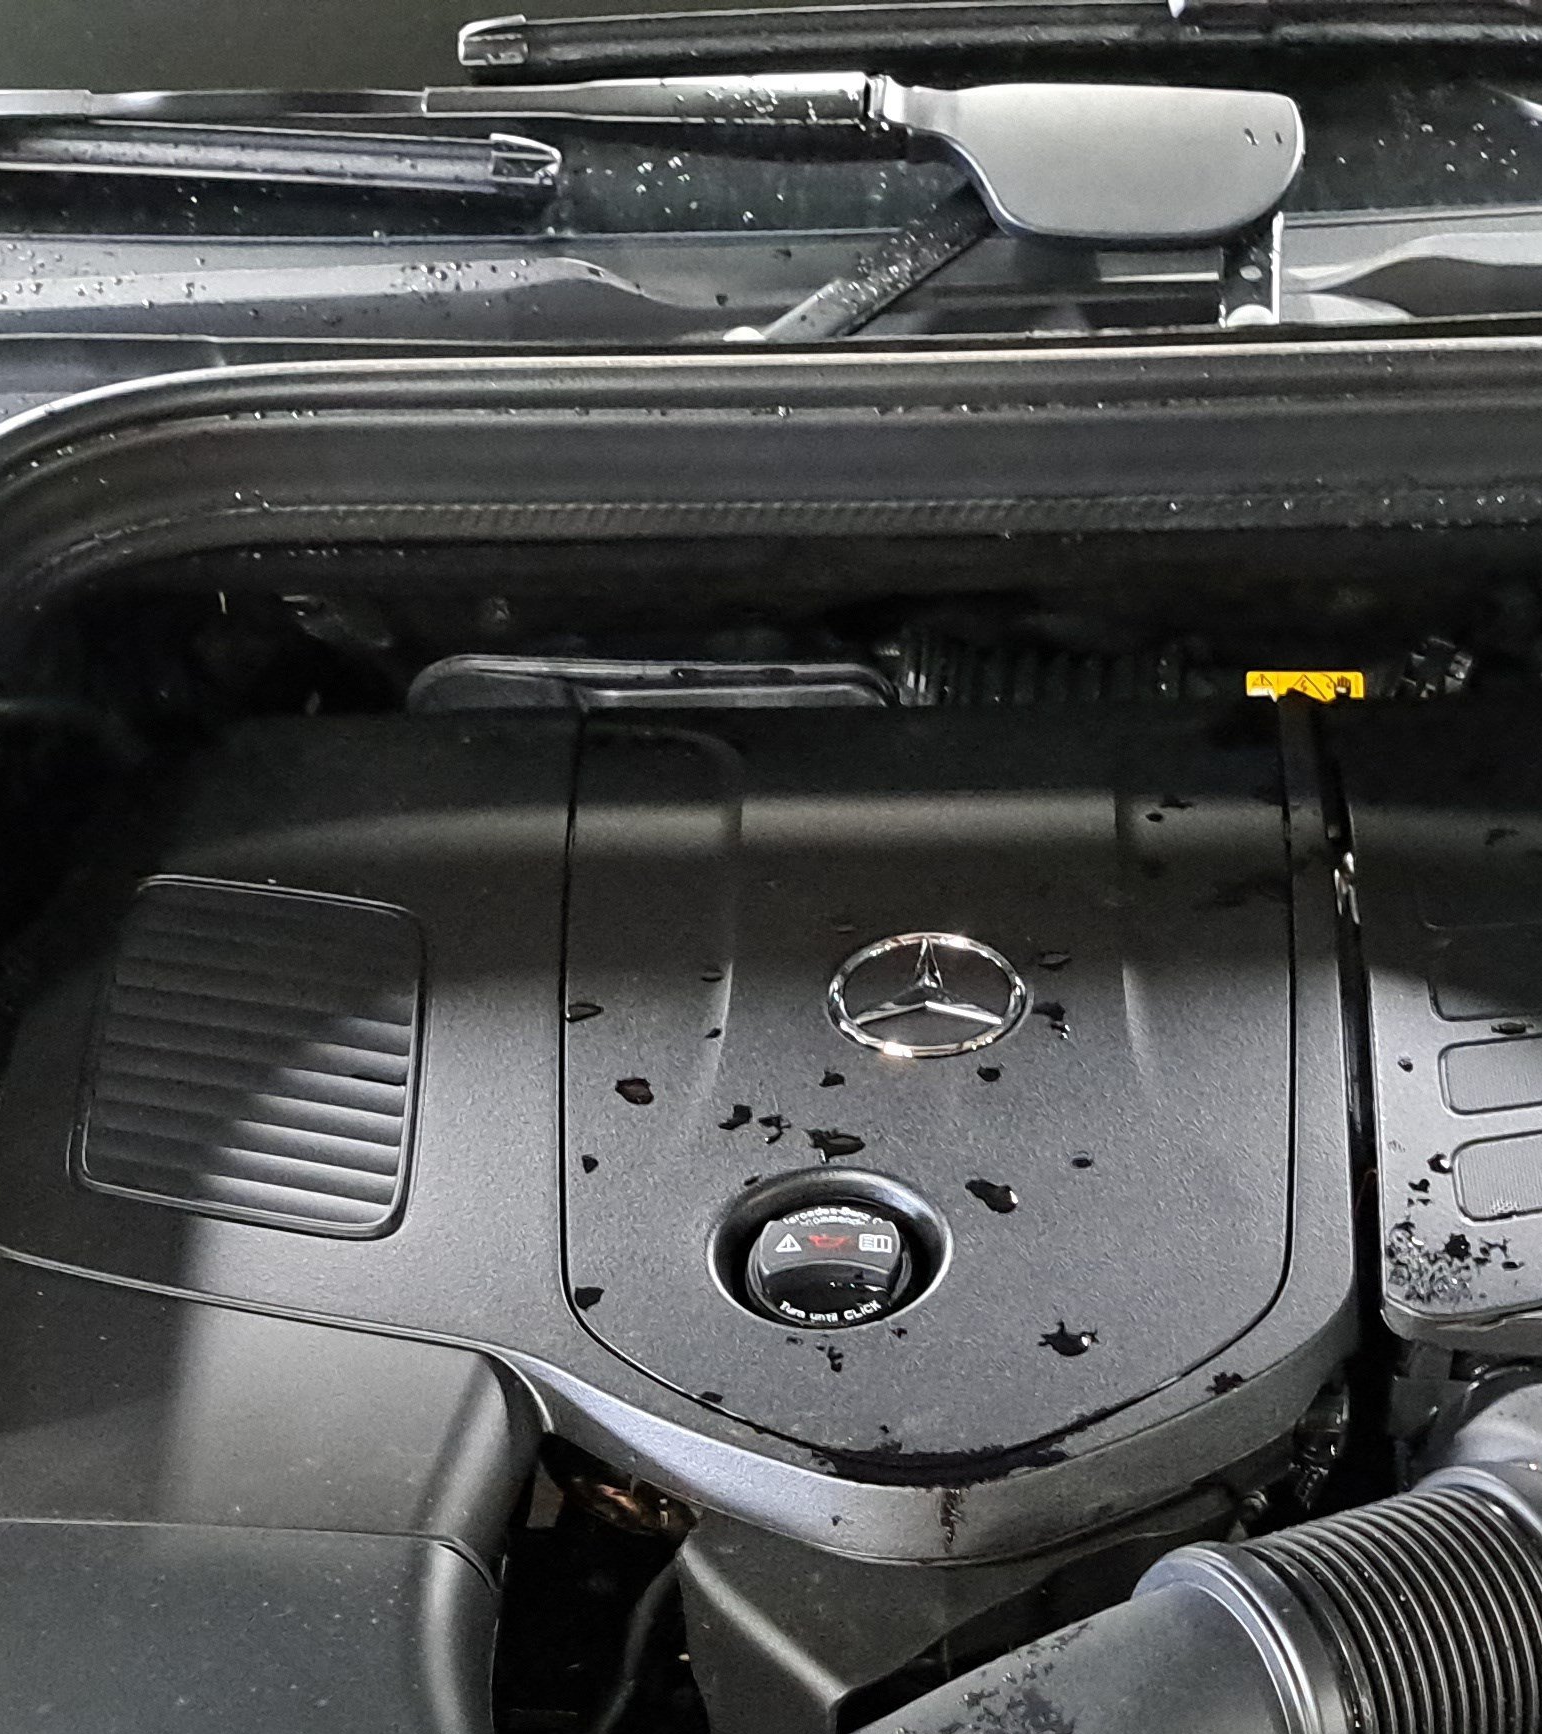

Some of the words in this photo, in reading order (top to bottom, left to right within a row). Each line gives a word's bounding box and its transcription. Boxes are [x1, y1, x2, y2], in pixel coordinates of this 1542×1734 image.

[779, 1300, 806, 1319] Turn
[809, 1312, 839, 1323] until
[843, 1299, 882, 1321] CLICK
